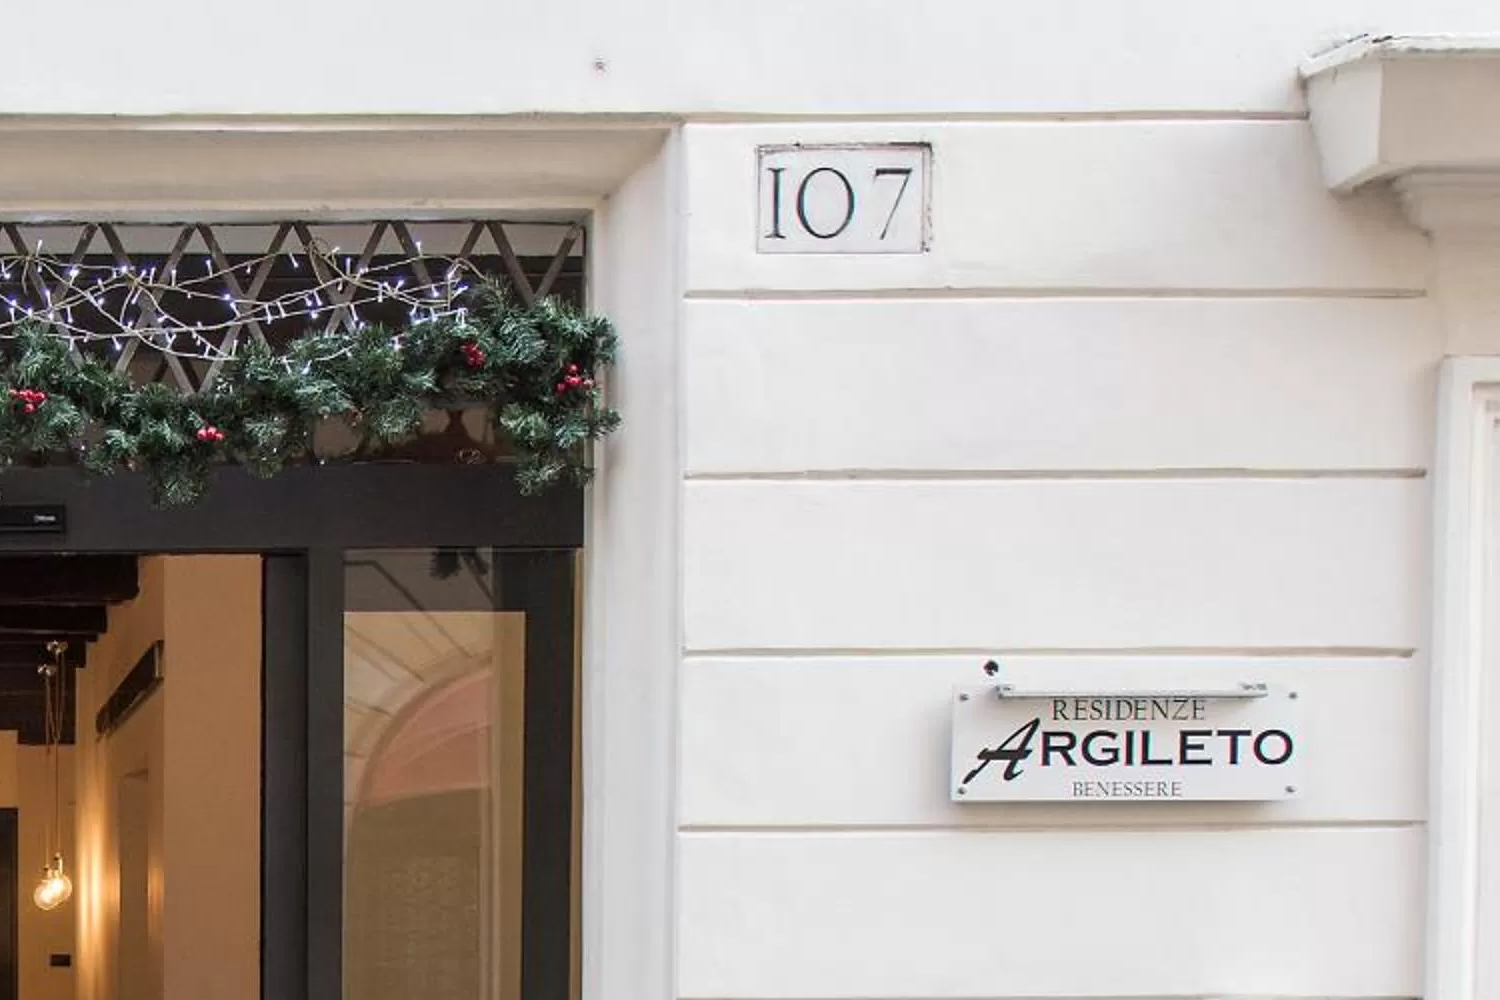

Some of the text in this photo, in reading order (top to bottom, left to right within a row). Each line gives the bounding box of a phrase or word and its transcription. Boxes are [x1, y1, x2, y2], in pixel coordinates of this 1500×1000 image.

[764, 166, 913, 240] 107
[1051, 697, 1206, 721] RESIDENZE
[962, 717, 1294, 785] ARGILETO
[1072, 781, 1182, 797] BENESSERE
